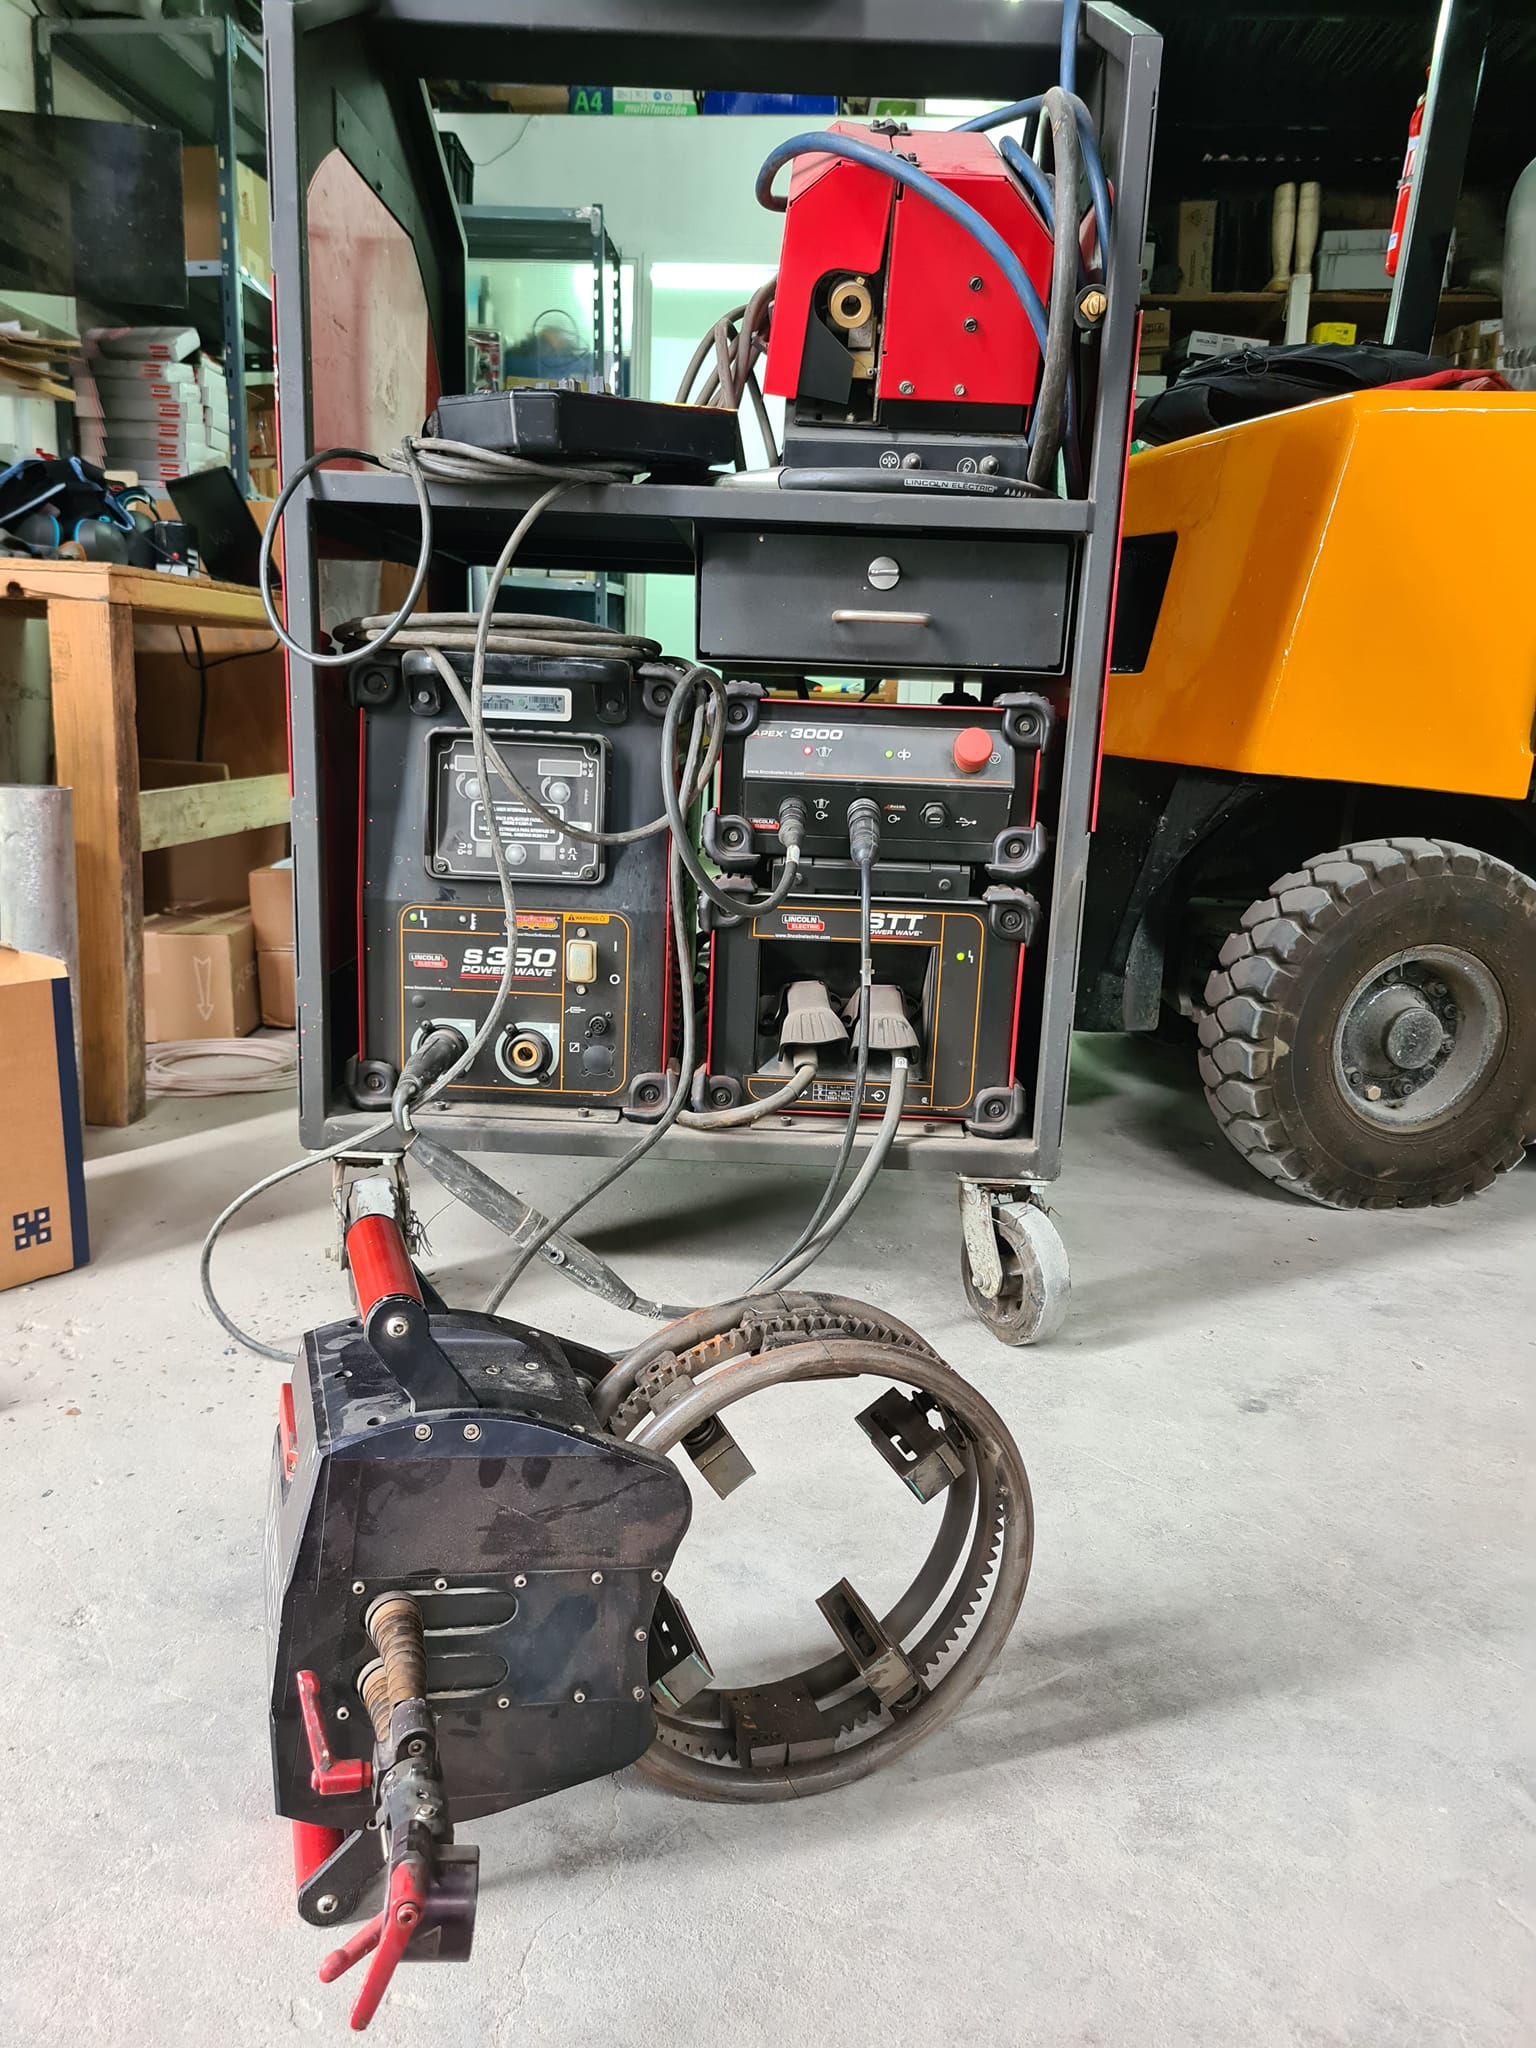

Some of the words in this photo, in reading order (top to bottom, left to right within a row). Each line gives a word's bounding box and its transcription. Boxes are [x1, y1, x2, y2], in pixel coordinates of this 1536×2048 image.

[574, 90, 603, 113] A4
[905, 479, 950, 488] LINCOLN
[951, 482, 995, 492] ELECTRIC
[790, 727, 843, 740] 3000
[784, 915, 818, 923] LINCOLN
[869, 912, 924, 931] STT
[791, 922, 821, 930] ELECTRIC
[514, 967, 553, 977] WAVE
